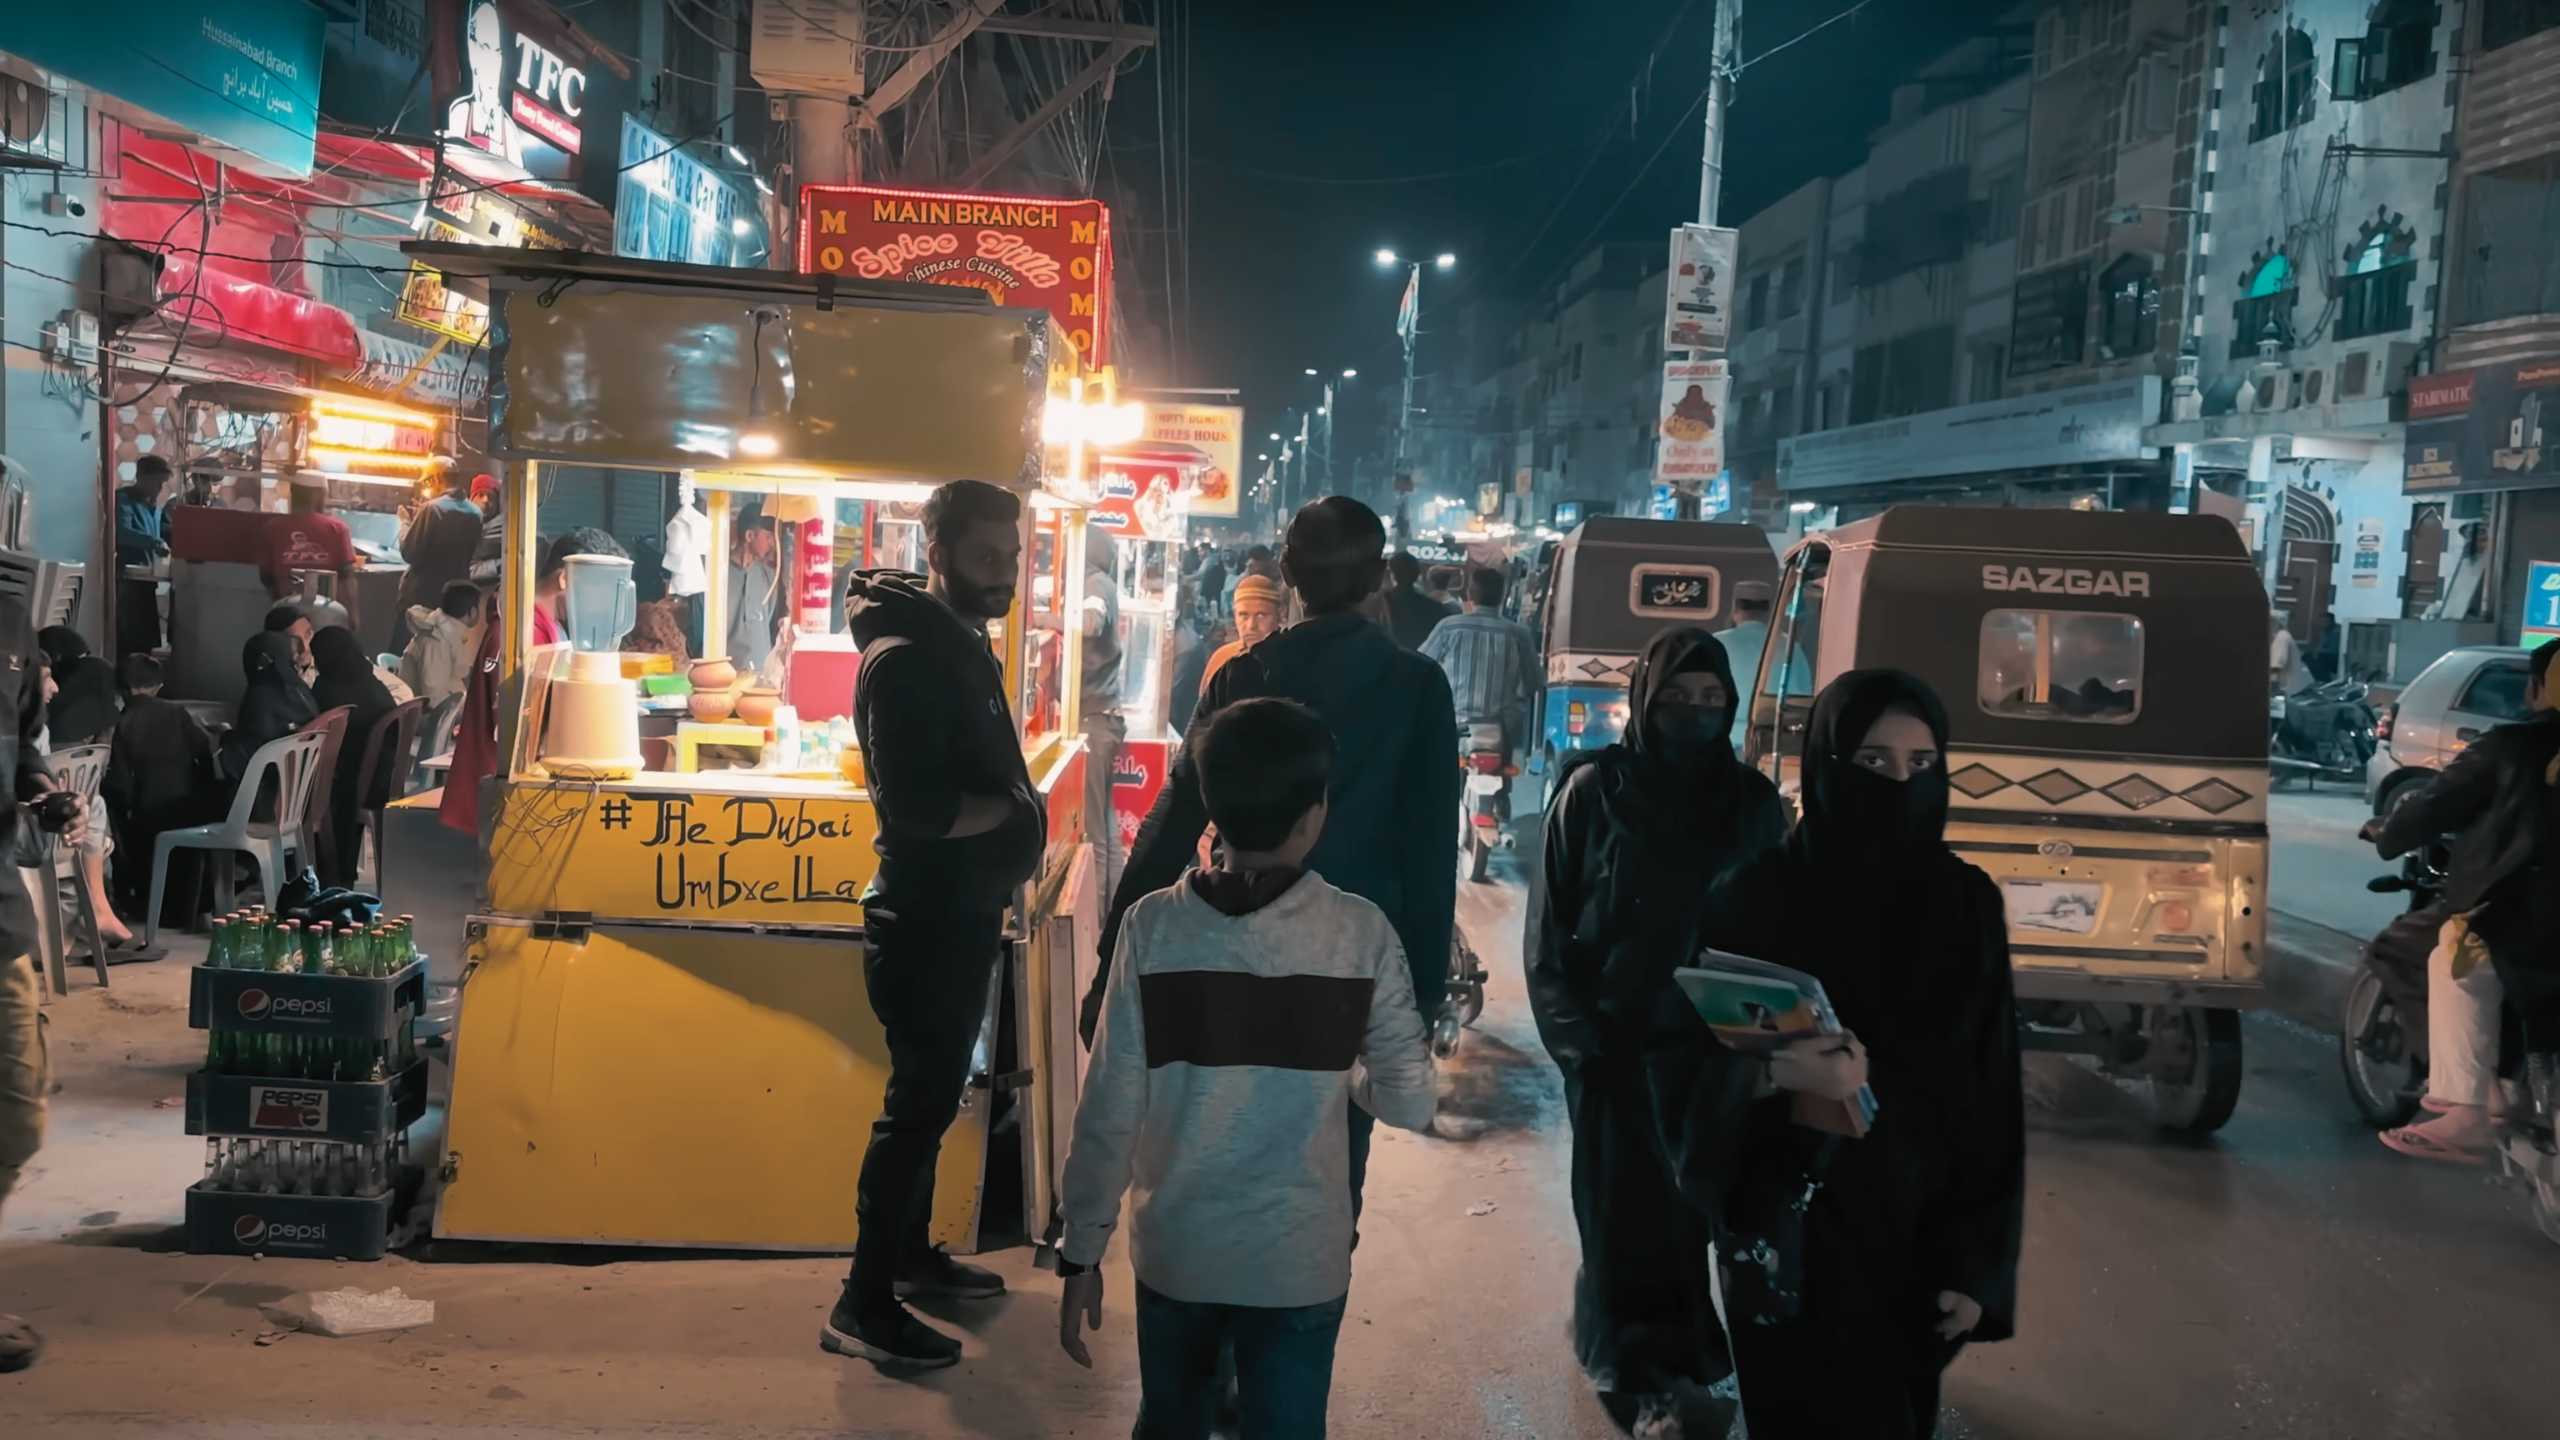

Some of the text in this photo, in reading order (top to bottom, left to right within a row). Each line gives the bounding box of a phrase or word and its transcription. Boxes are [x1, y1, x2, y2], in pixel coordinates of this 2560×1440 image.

[202, 16, 297, 80] Hussainabad Branch
[516, 32, 585, 117] TFC
[873, 200, 1058, 228] MAIN BRANCH
[851, 233, 958, 279] Spice
[905, 256, 1021, 289] Chinese Cuisine
[1194, 430, 1231, 442] HOUS
[1982, 564, 2150, 598] SAZGAR
[271, 996, 332, 1016] pepsi
[261, 1090, 323, 1107] PEPSI
[268, 1223, 326, 1241] pepsi
